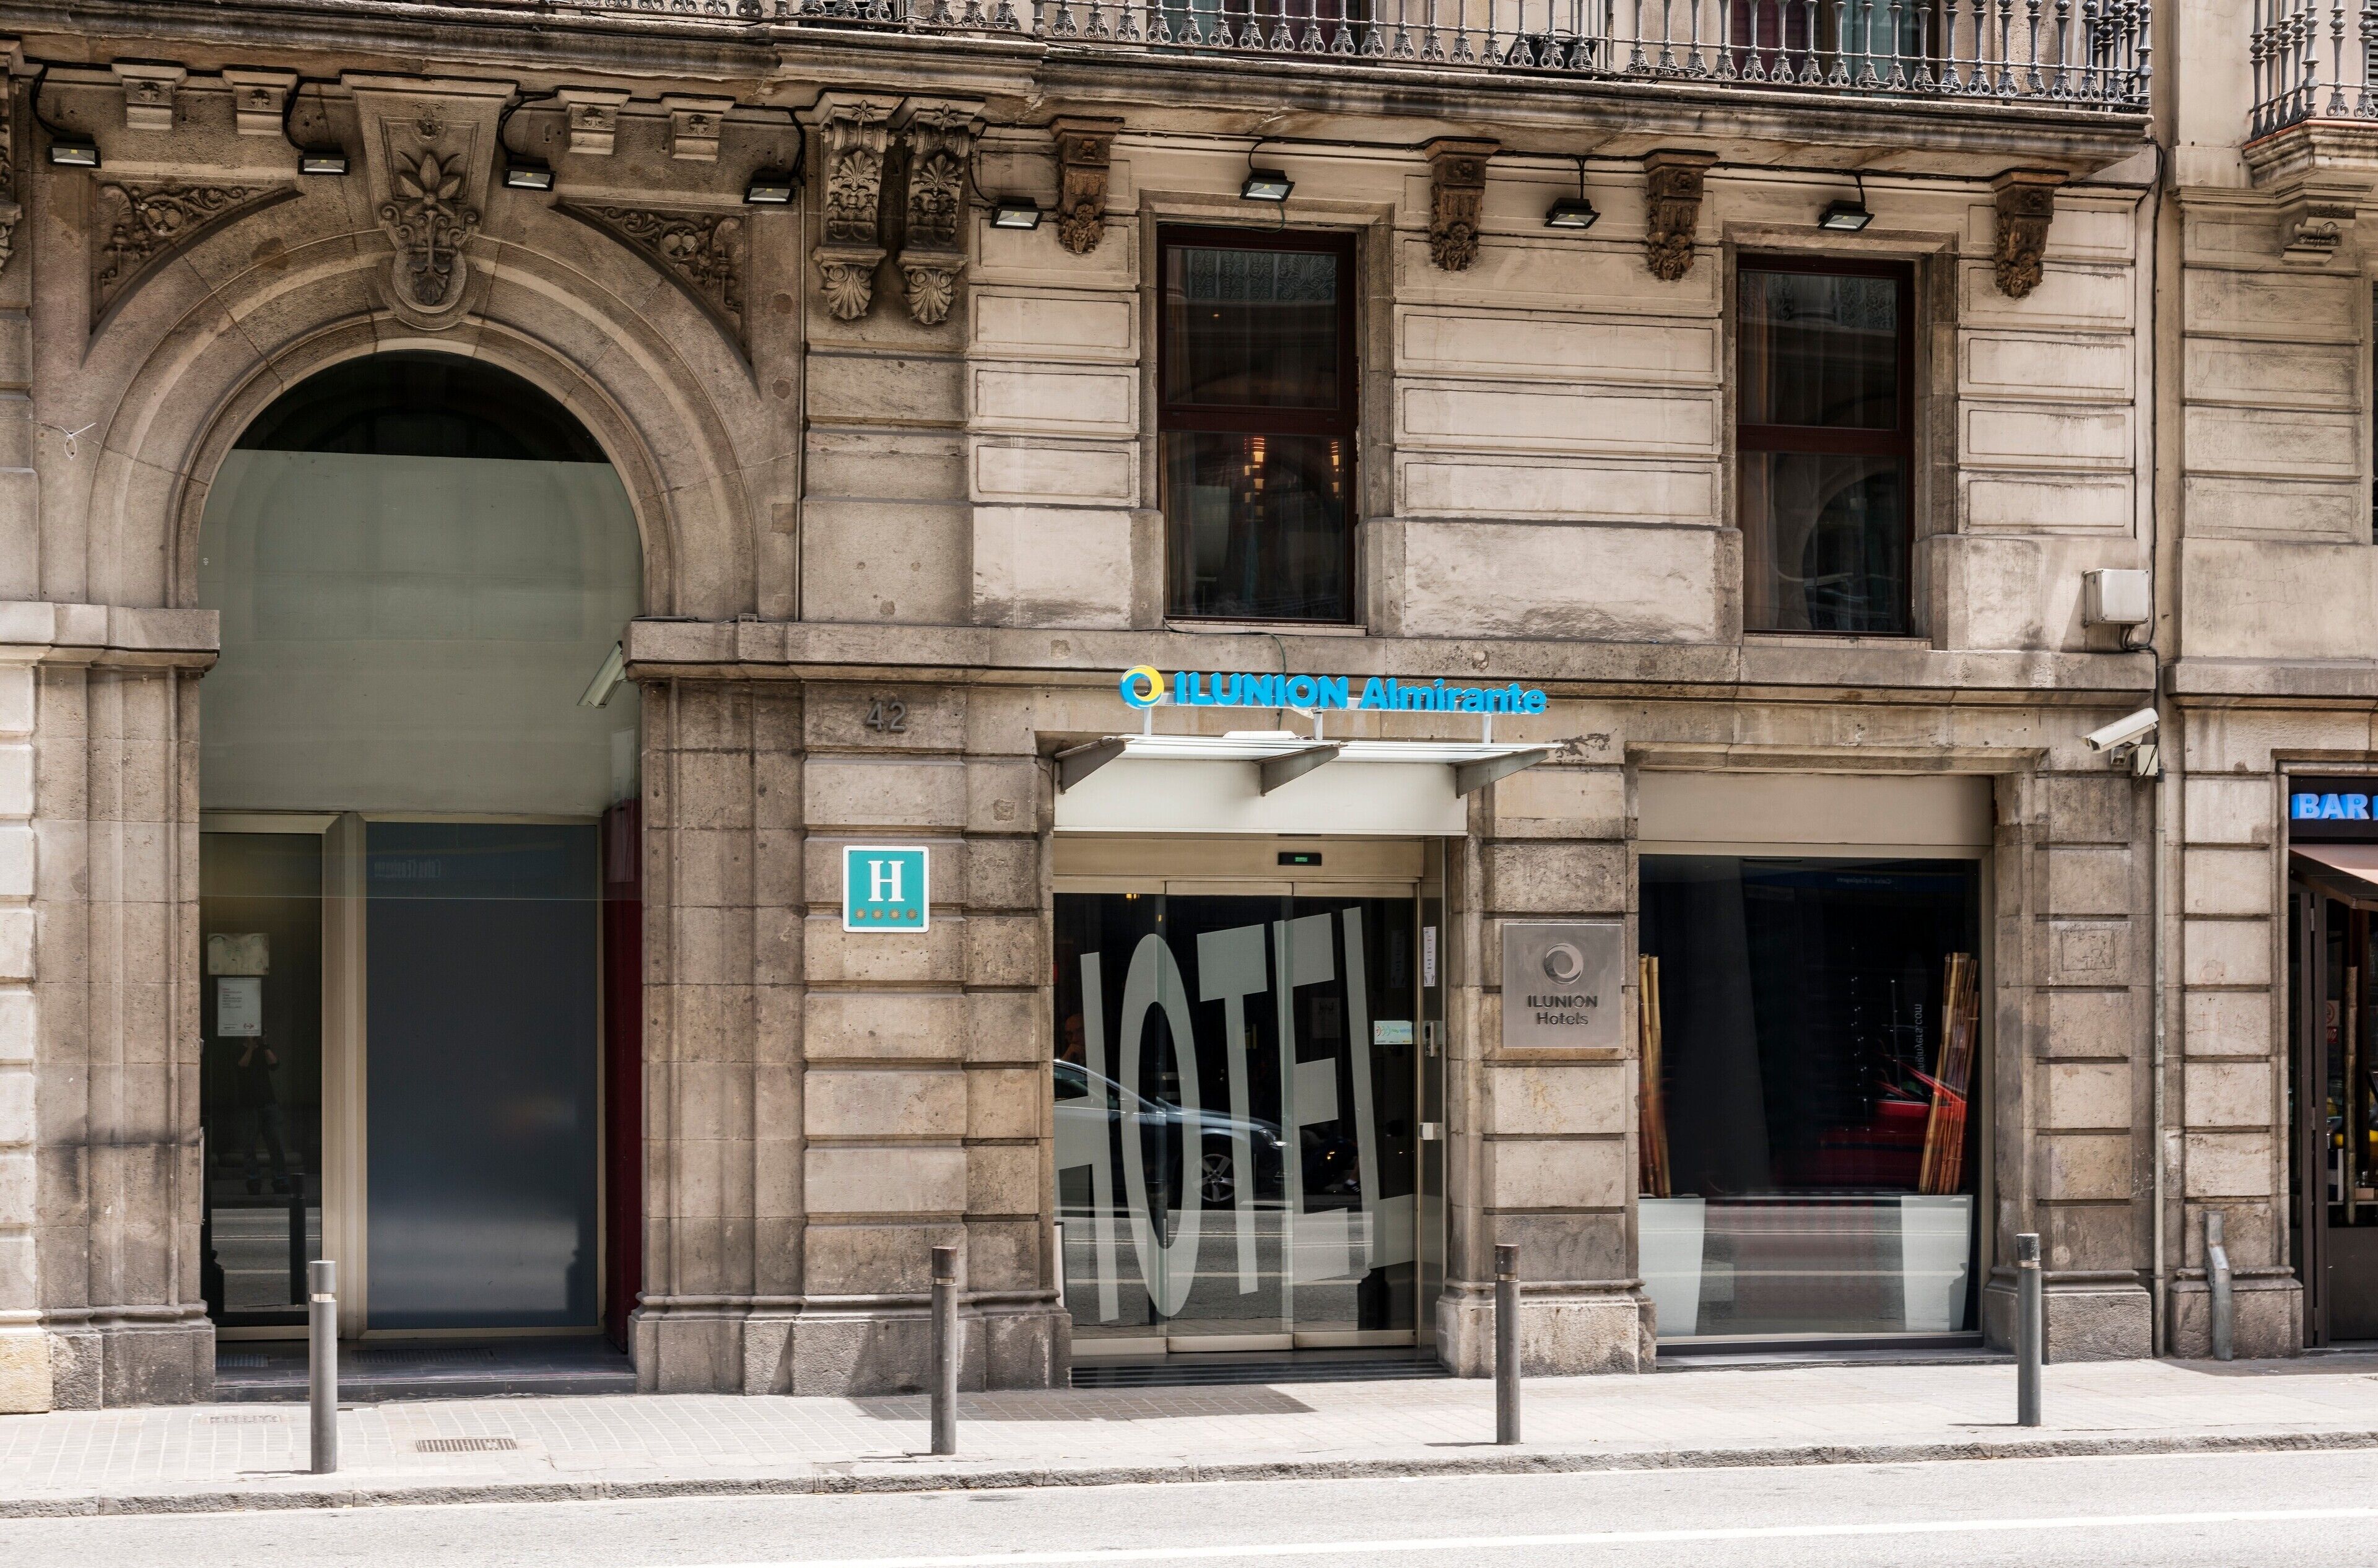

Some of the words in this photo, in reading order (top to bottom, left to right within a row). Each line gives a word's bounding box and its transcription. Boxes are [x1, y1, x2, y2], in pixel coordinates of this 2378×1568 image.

[1174, 671, 1349, 709] ILUNION
[1360, 677, 1548, 715] Almirante
[866, 701, 907, 732] 42
[2291, 793, 2370, 819] BAR
[868, 860, 905, 902] H
[1527, 995, 1598, 1009] ILUNION
[1536, 1011, 1589, 1026] Hotels
[1053, 907, 1414, 1323] HOTEL
